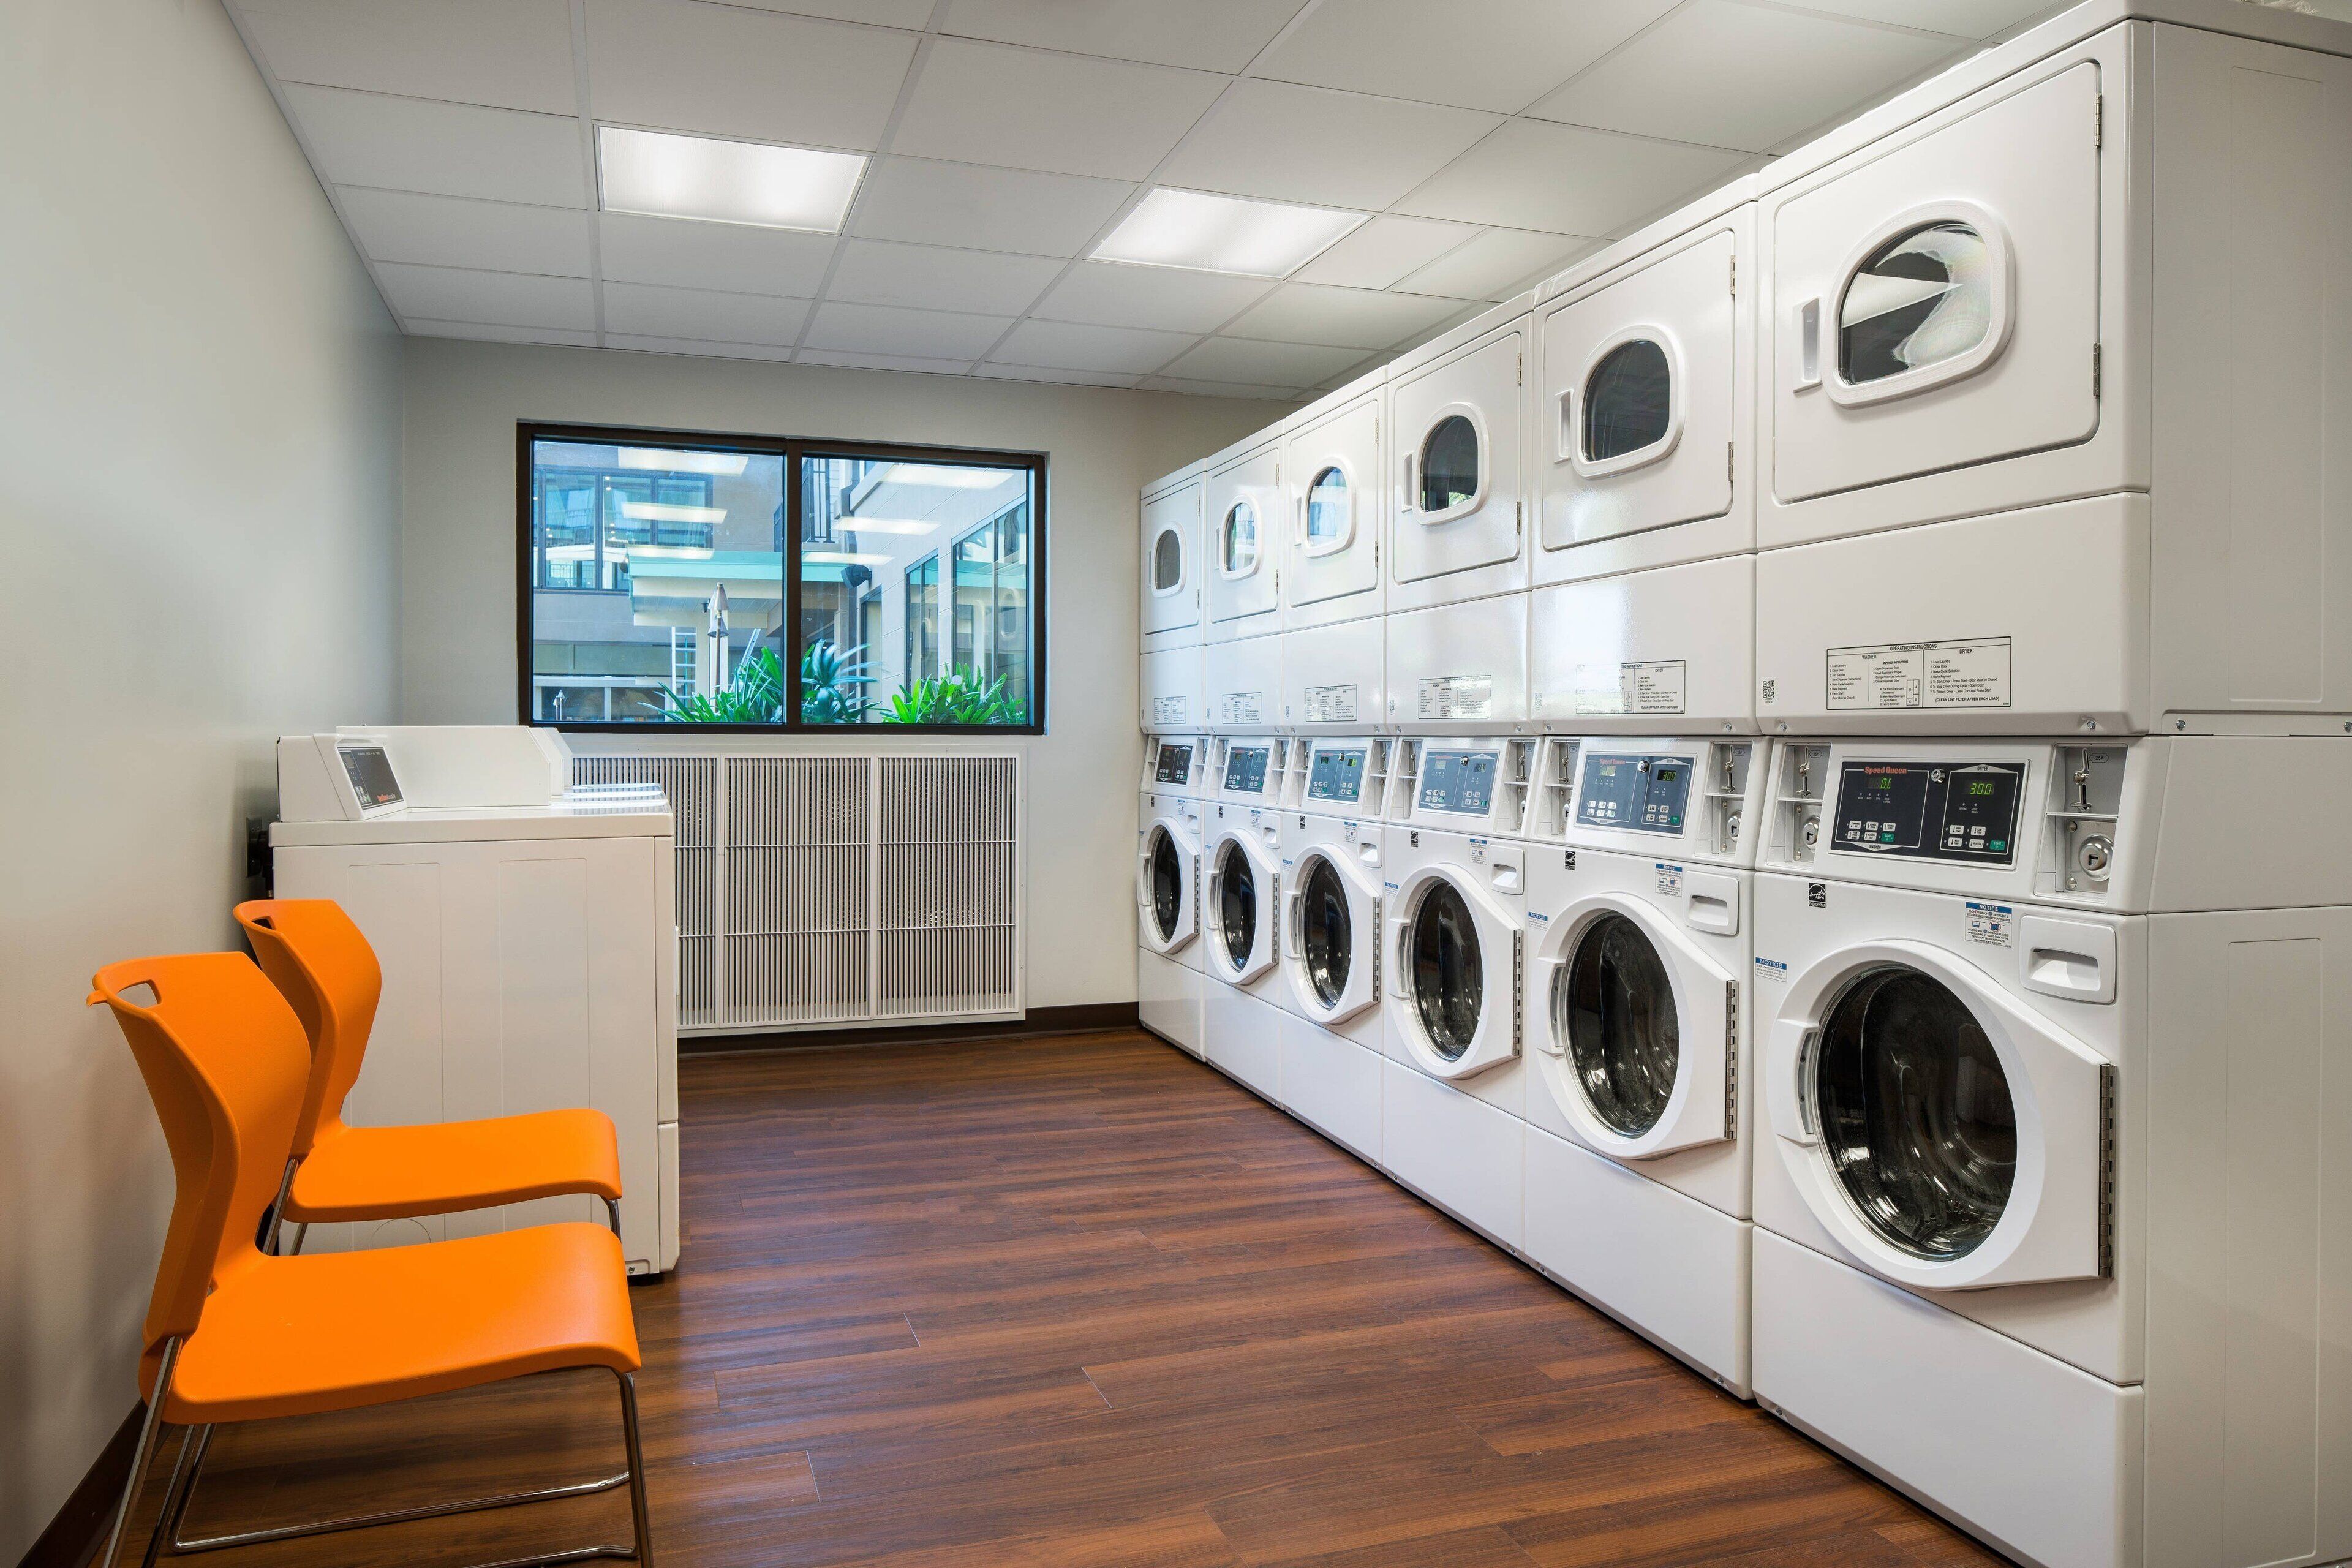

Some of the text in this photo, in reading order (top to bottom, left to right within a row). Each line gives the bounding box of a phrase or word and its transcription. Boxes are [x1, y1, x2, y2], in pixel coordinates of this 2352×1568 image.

[1663, 771, 1676, 781] 300
[1970, 783, 1992, 795] 300
[1760, 959, 1783, 968] NOTICE
